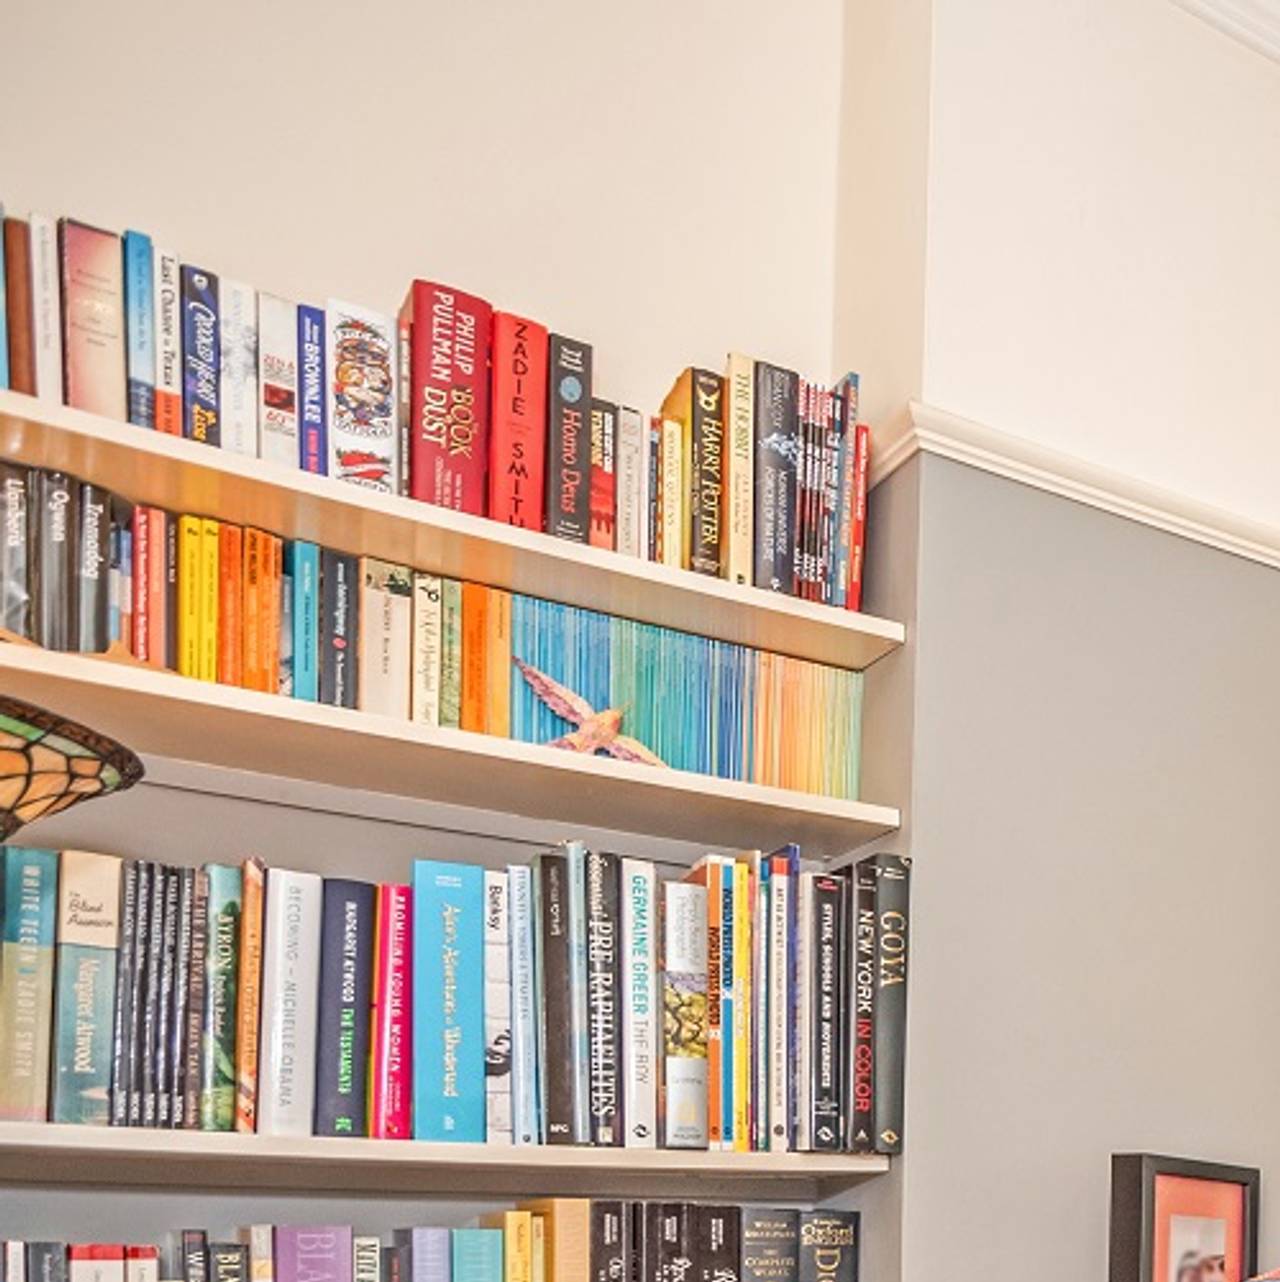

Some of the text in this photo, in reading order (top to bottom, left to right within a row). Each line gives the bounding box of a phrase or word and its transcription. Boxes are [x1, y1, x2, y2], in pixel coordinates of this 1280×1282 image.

[160, 255, 175, 286] Last
[160, 288, 178, 336] Chance
[431, 291, 475, 382] PHILIP PULLMAN
[162, 349, 178, 388] Texas
[304, 343, 321, 424] BROWNLEE
[512, 322, 529, 417] ZADIE
[422, 386, 448, 448] DUST
[450, 388, 474, 459] BOOK
[735, 373, 750, 460] THE HOBBIT
[560, 407, 583, 514] Homo Deus
[700, 416, 723, 545] HARRY POTTER
[5, 478, 25, 547] Llanberis
[48, 489, 71, 542] Ogwen
[81, 502, 105, 580] Tremadog
[191, 900, 205, 926] THE
[486, 884, 504, 931] Banksy
[722, 887, 734, 988] WORLD PRESS PHOTO
[14, 864, 42, 1077] WHITE TEETH ZADIE SMITH
[190, 932, 204, 992] ARRIVAL
[390, 894, 406, 1072] PROMISING YOUNG WOMEN
[442, 944, 461, 1014] Adventures
[632, 874, 650, 1084] GERMAINE GREER THE BOY
[709, 926, 720, 1026] WORLD PRESS PHOTO
[820, 944, 832, 991] SCHOOLS
[879, 909, 906, 988] GOYA
[73, 957, 100, 1074] Margaret Atwood
[279, 885, 302, 1109] BECOMING MICHELLE OBAMA
[338, 900, 358, 1094] MARGARET ATWOOD THE TESTAMENTS
[588, 918, 616, 1116] PRE-RAPHAELITES
[821, 994, 832, 1018] AND
[855, 908, 874, 1112] NEW YORK IN COLOR
[442, 1025, 463, 1097] Wonderland
[821, 1021, 832, 1088] MOVEMENTS
[356, 1243, 378, 1275] MAYA
